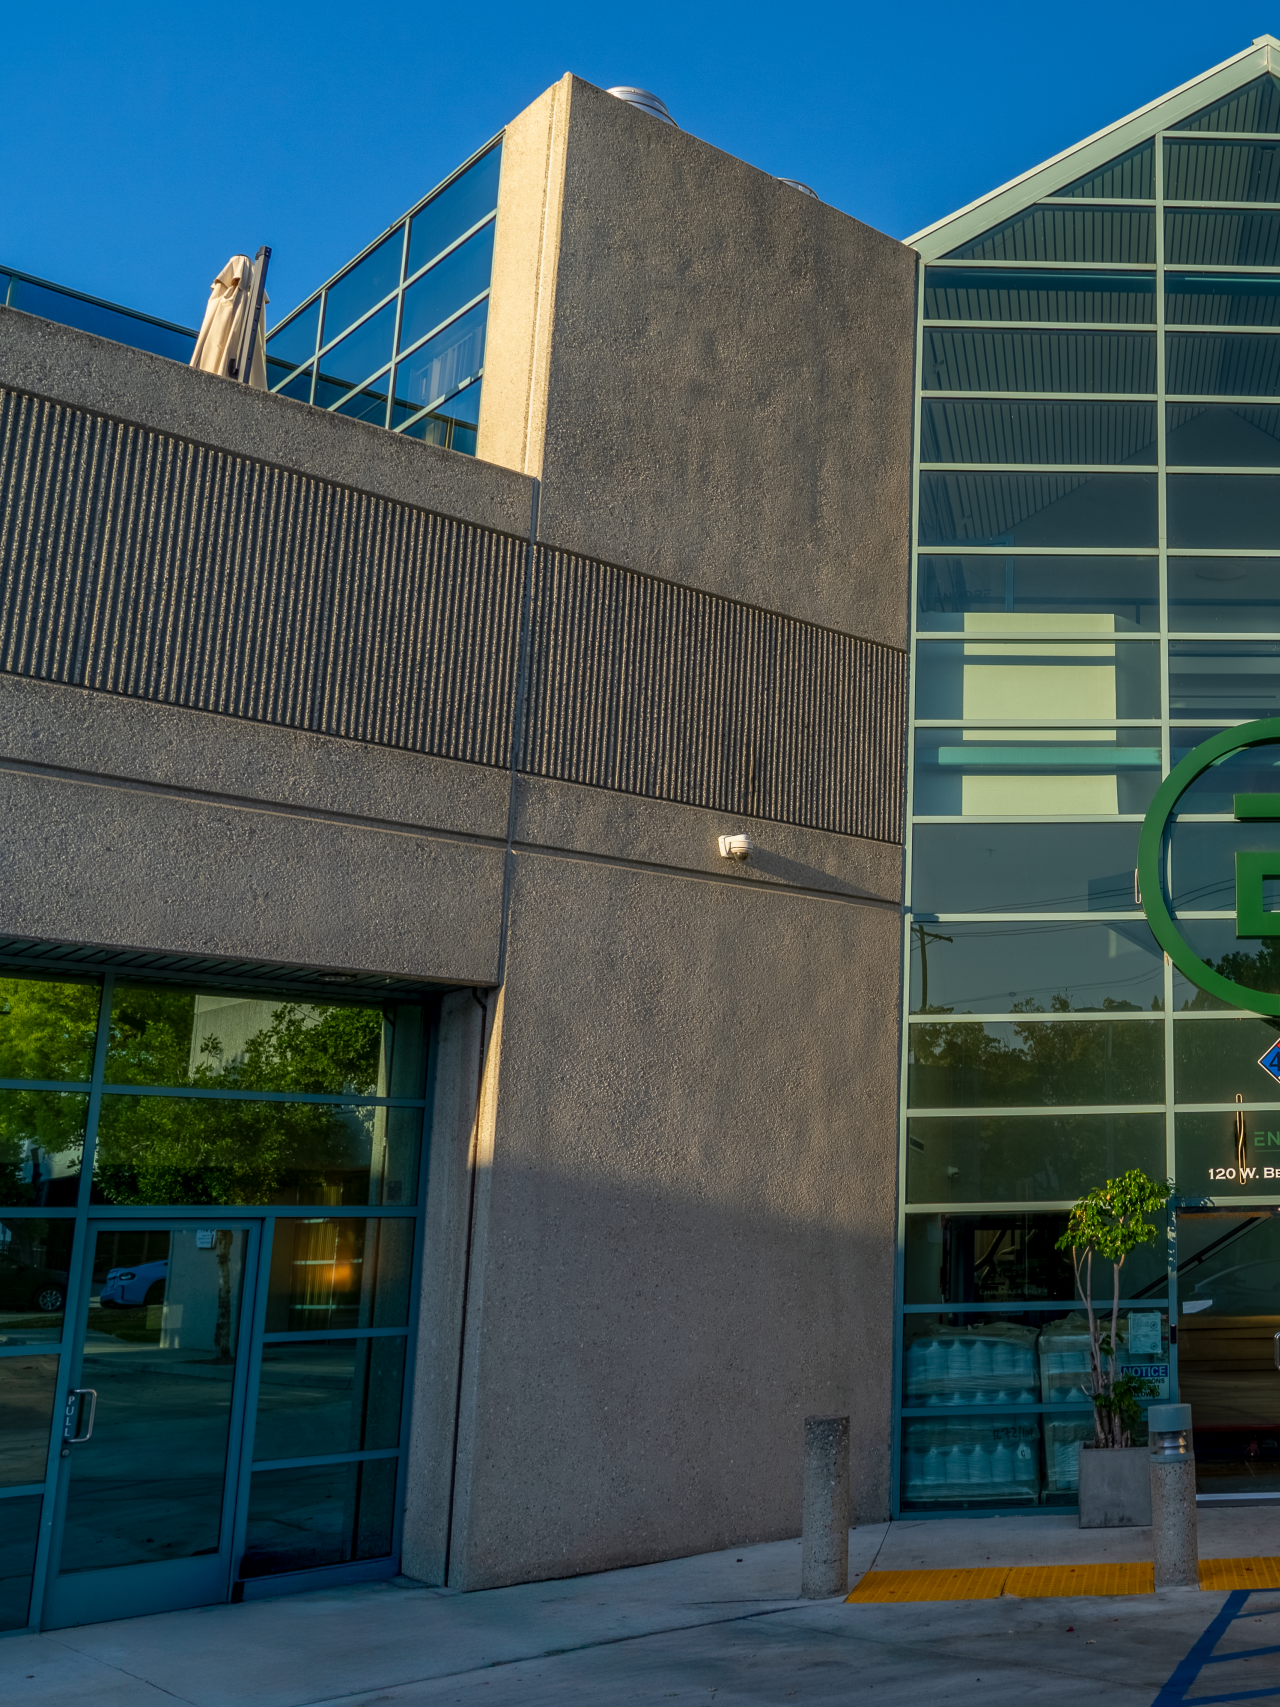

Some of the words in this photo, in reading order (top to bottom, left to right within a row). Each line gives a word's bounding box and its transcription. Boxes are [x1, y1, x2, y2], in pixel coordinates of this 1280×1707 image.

[1208, 1168, 1236, 1180] 120
[1240, 1167, 1259, 1179] W.
[1122, 1366, 1166, 1377] NOTICE
[64, 1395, 75, 1437] PULL
